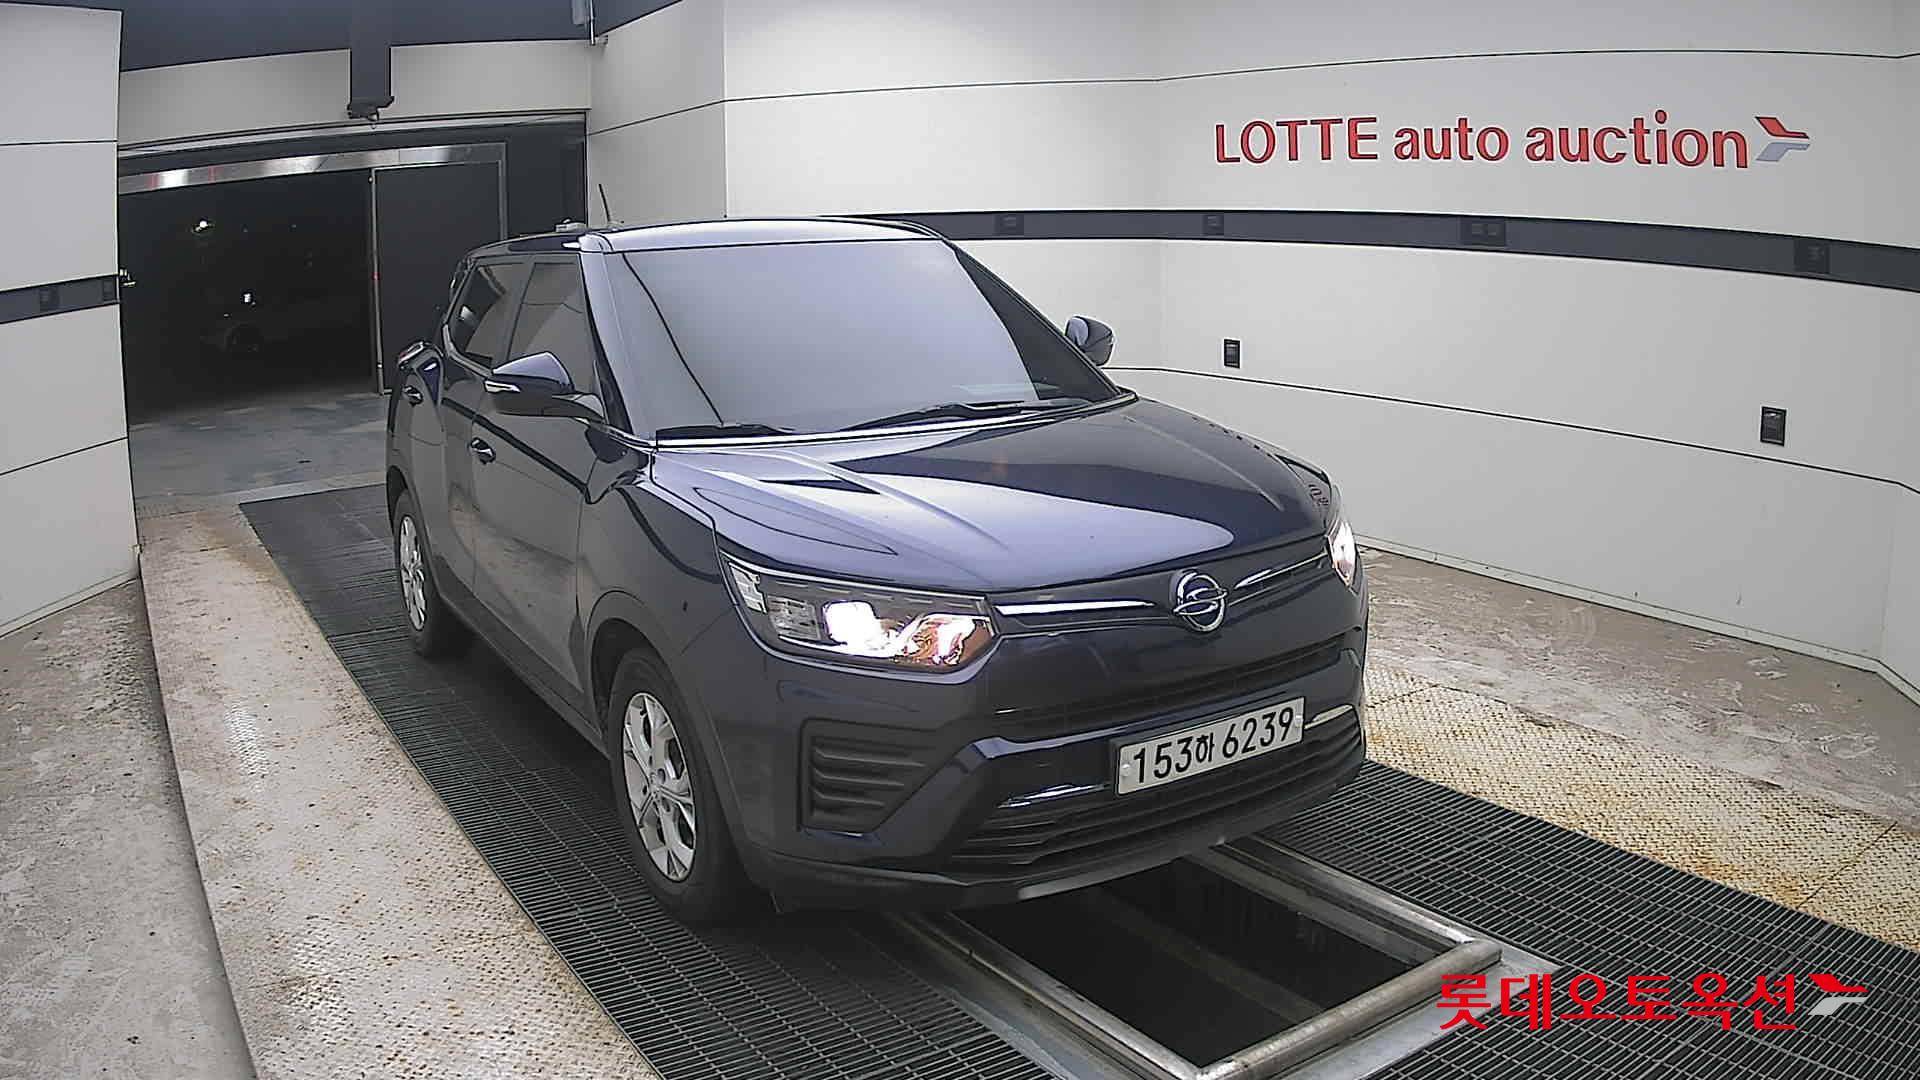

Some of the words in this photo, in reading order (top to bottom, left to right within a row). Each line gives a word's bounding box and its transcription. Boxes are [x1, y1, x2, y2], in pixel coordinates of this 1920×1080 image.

[1214, 117, 1378, 163] LOTTE
[1394, 117, 1510, 160] auto
[1525, 110, 1748, 168] auction
[1133, 731, 1215, 783] 153하
[1222, 707, 1294, 758] 6239
